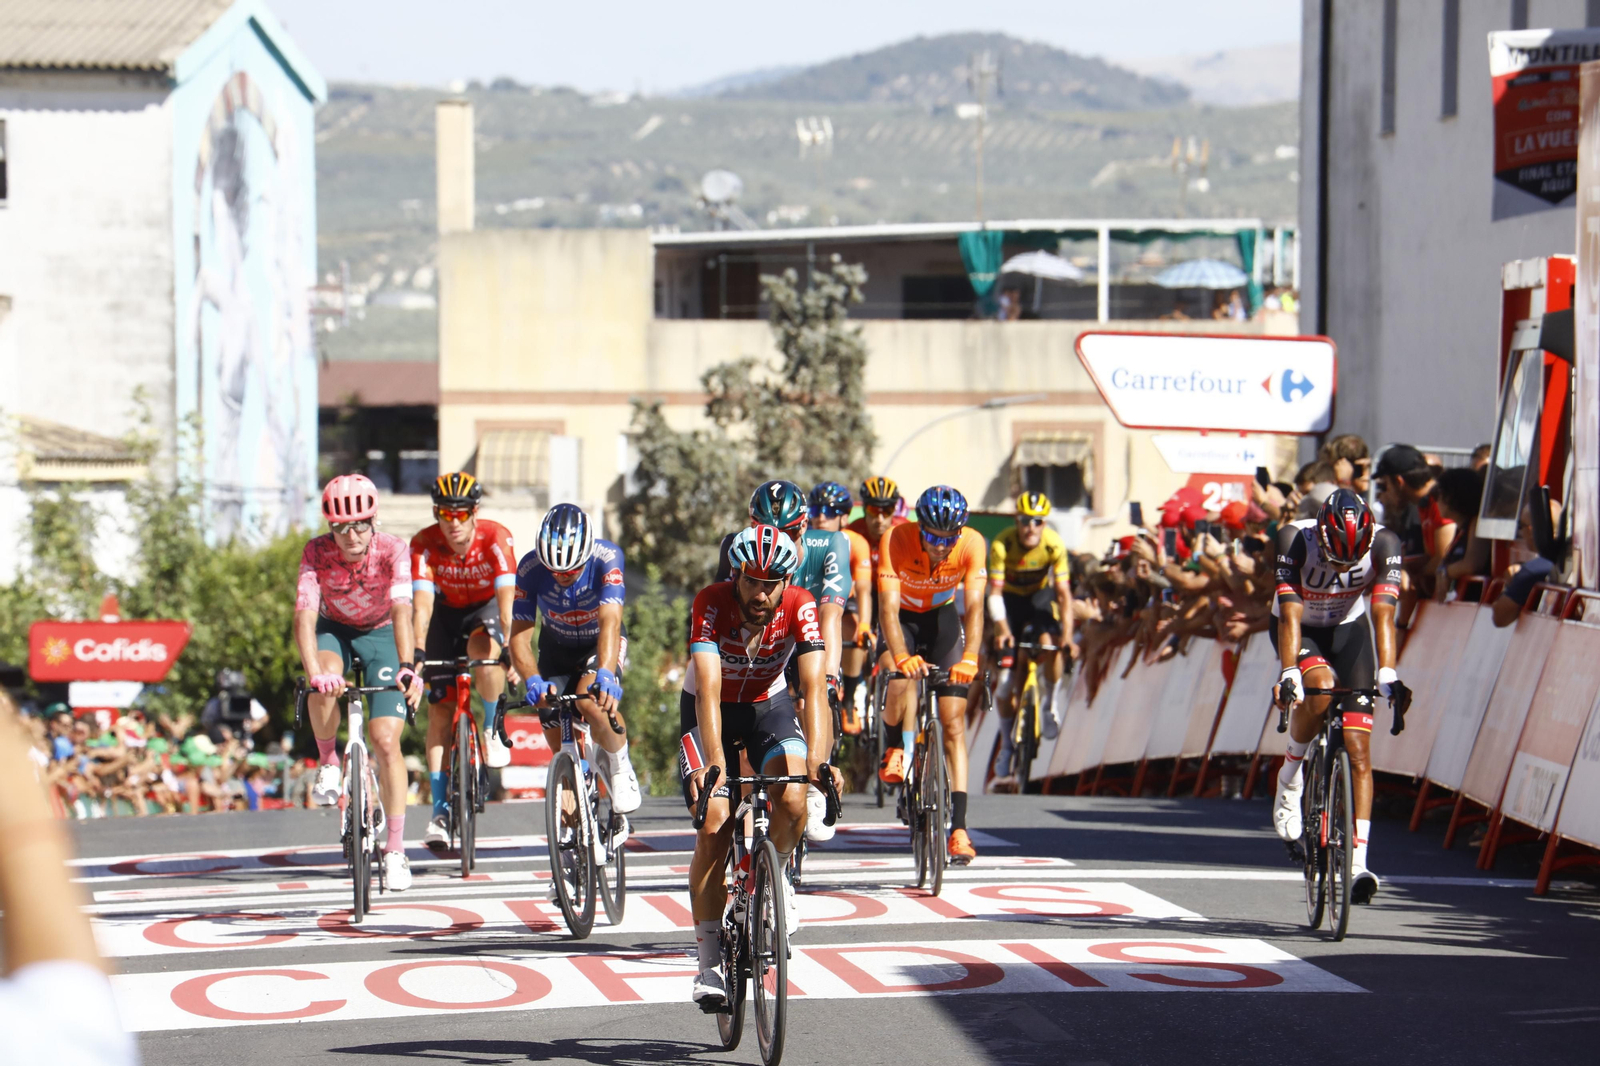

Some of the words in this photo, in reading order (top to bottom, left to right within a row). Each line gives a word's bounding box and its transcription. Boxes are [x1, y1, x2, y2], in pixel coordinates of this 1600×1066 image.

[1514, 134, 1535, 154] LA
[1111, 367, 1247, 395] Carrefour
[806, 538, 829, 547] BORA
[437, 562, 493, 576] BAHRAIN
[1305, 567, 1364, 589] UAE
[550, 623, 600, 635] deceuninc
[700, 605, 718, 641] OUDAL
[73, 637, 167, 662] Cofidis
